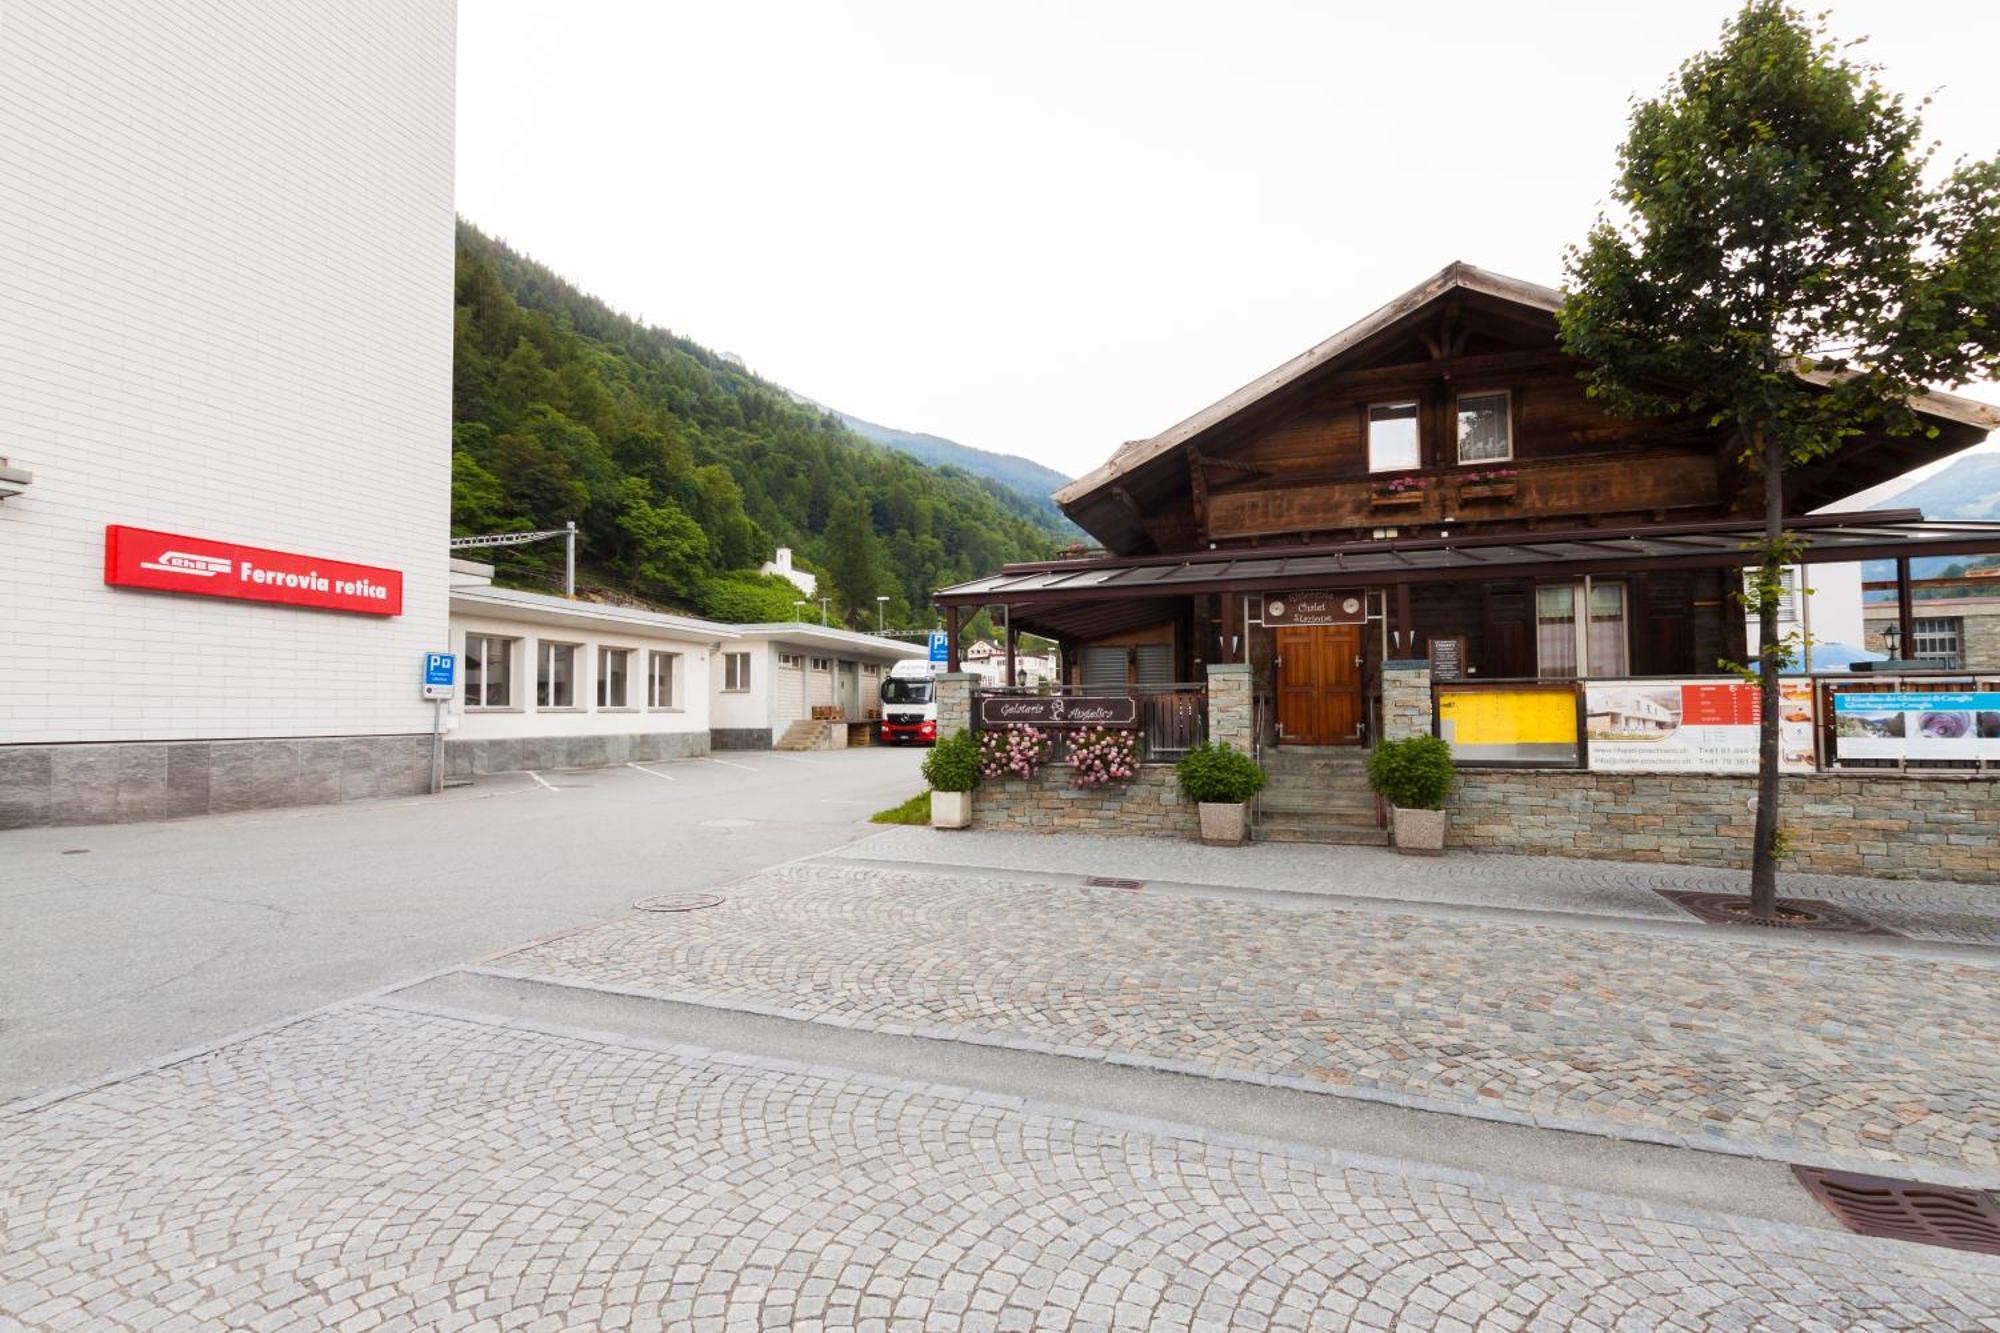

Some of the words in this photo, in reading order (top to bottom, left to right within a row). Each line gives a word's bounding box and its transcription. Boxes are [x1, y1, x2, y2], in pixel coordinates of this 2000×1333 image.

[240, 562, 329, 592] Ferrovia
[335, 578, 387, 599] retica
[1298, 602, 1326, 612] Chalet
[934, 635, 944, 650] P
[430, 655, 441, 671] P
[1000, 703, 1043, 716] Gelateria
